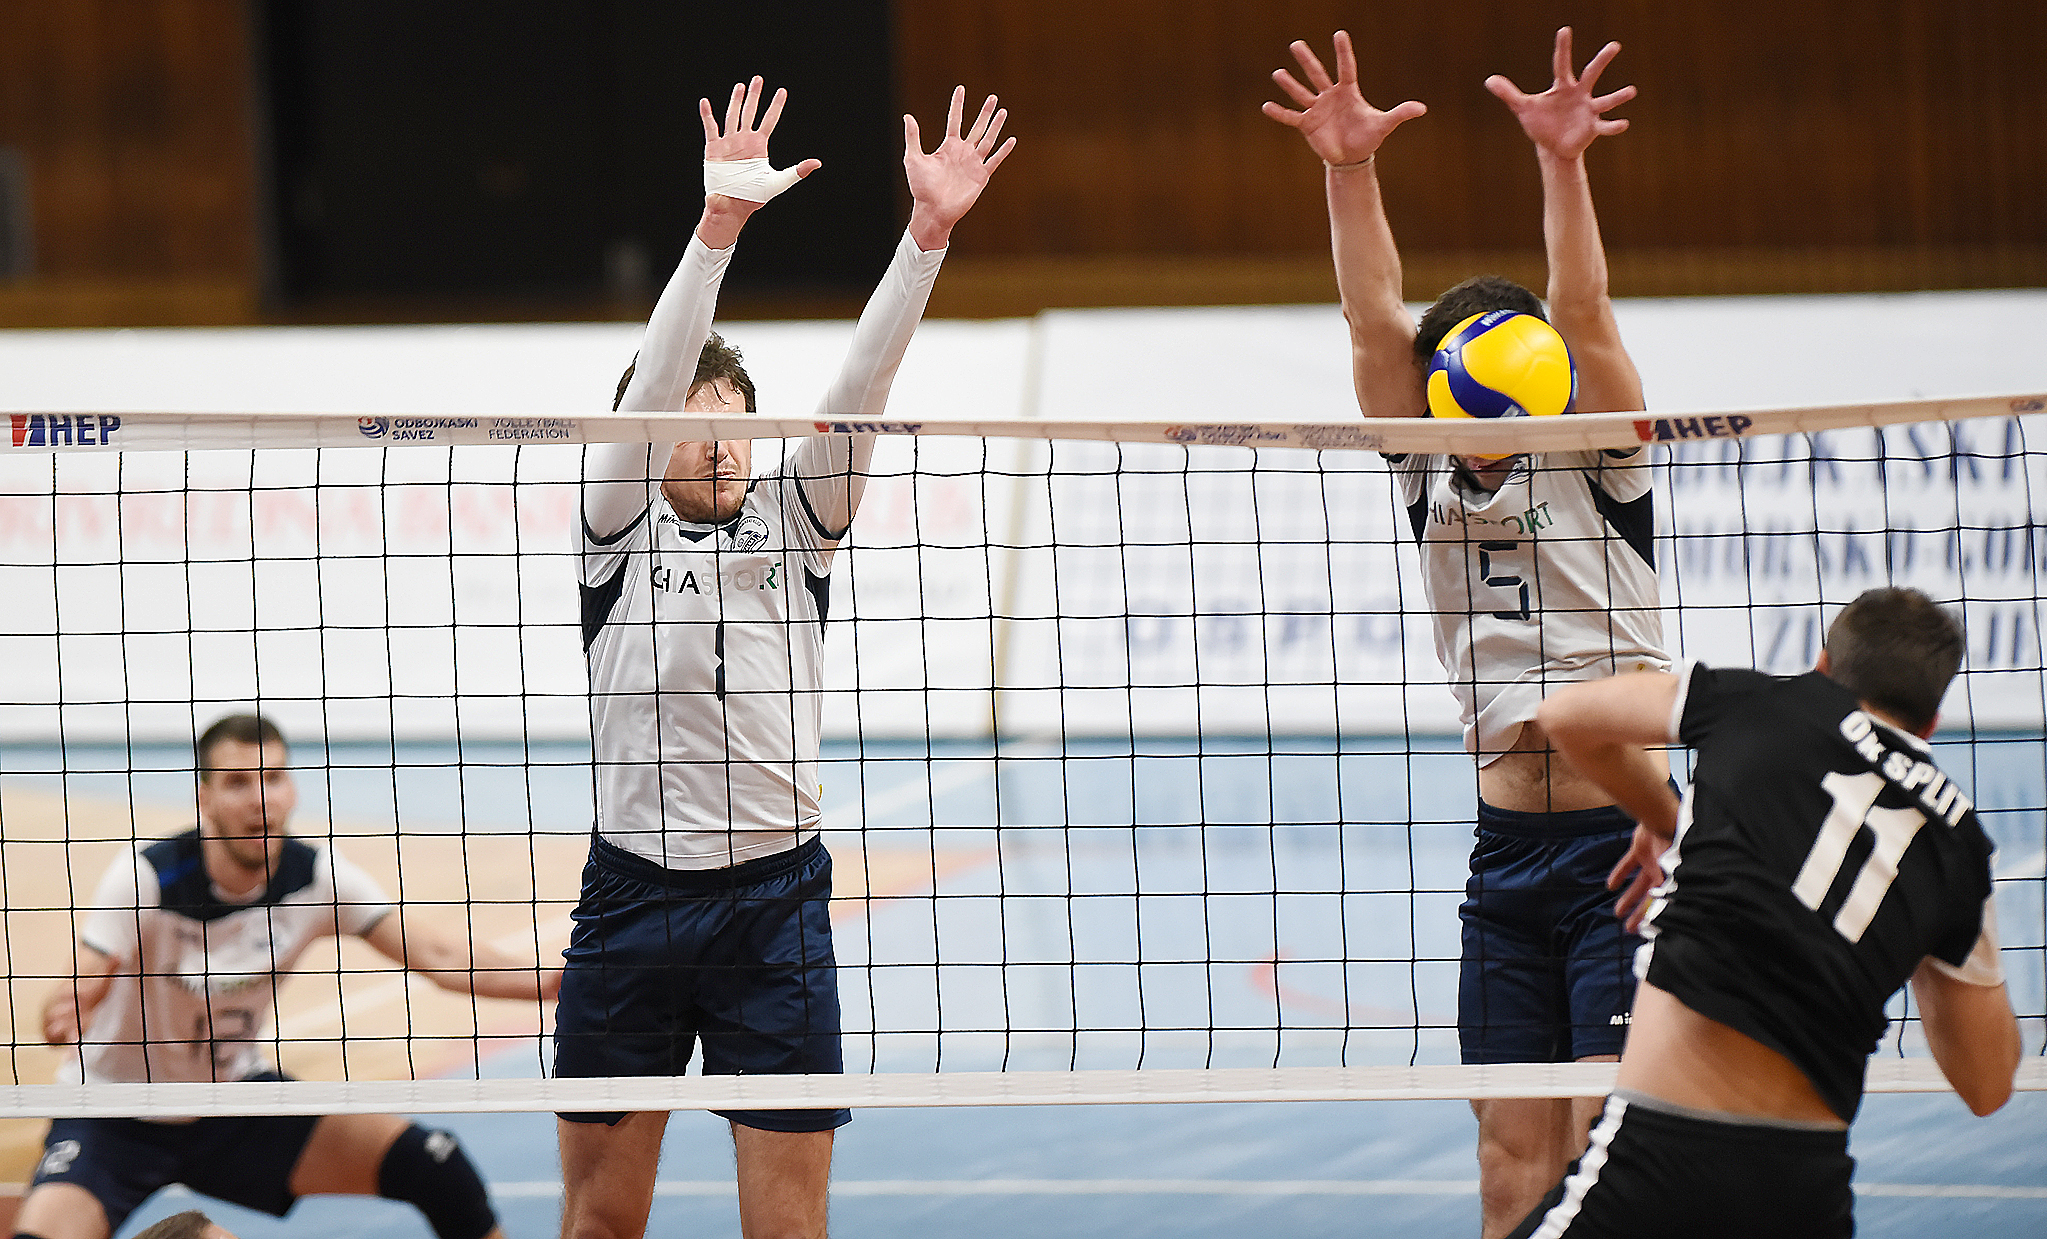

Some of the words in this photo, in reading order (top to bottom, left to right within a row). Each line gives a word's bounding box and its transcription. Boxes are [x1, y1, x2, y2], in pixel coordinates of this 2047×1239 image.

[48, 413, 121, 447] HEP
[391, 429, 435, 440] SAVEZ
[488, 428, 571, 440] FEDERATION
[1673, 415, 1753, 439] HEP
[1478, 541, 1531, 622] 5
[1882, 751, 1974, 827] SPLIT
[1791, 770, 1928, 944] 11
